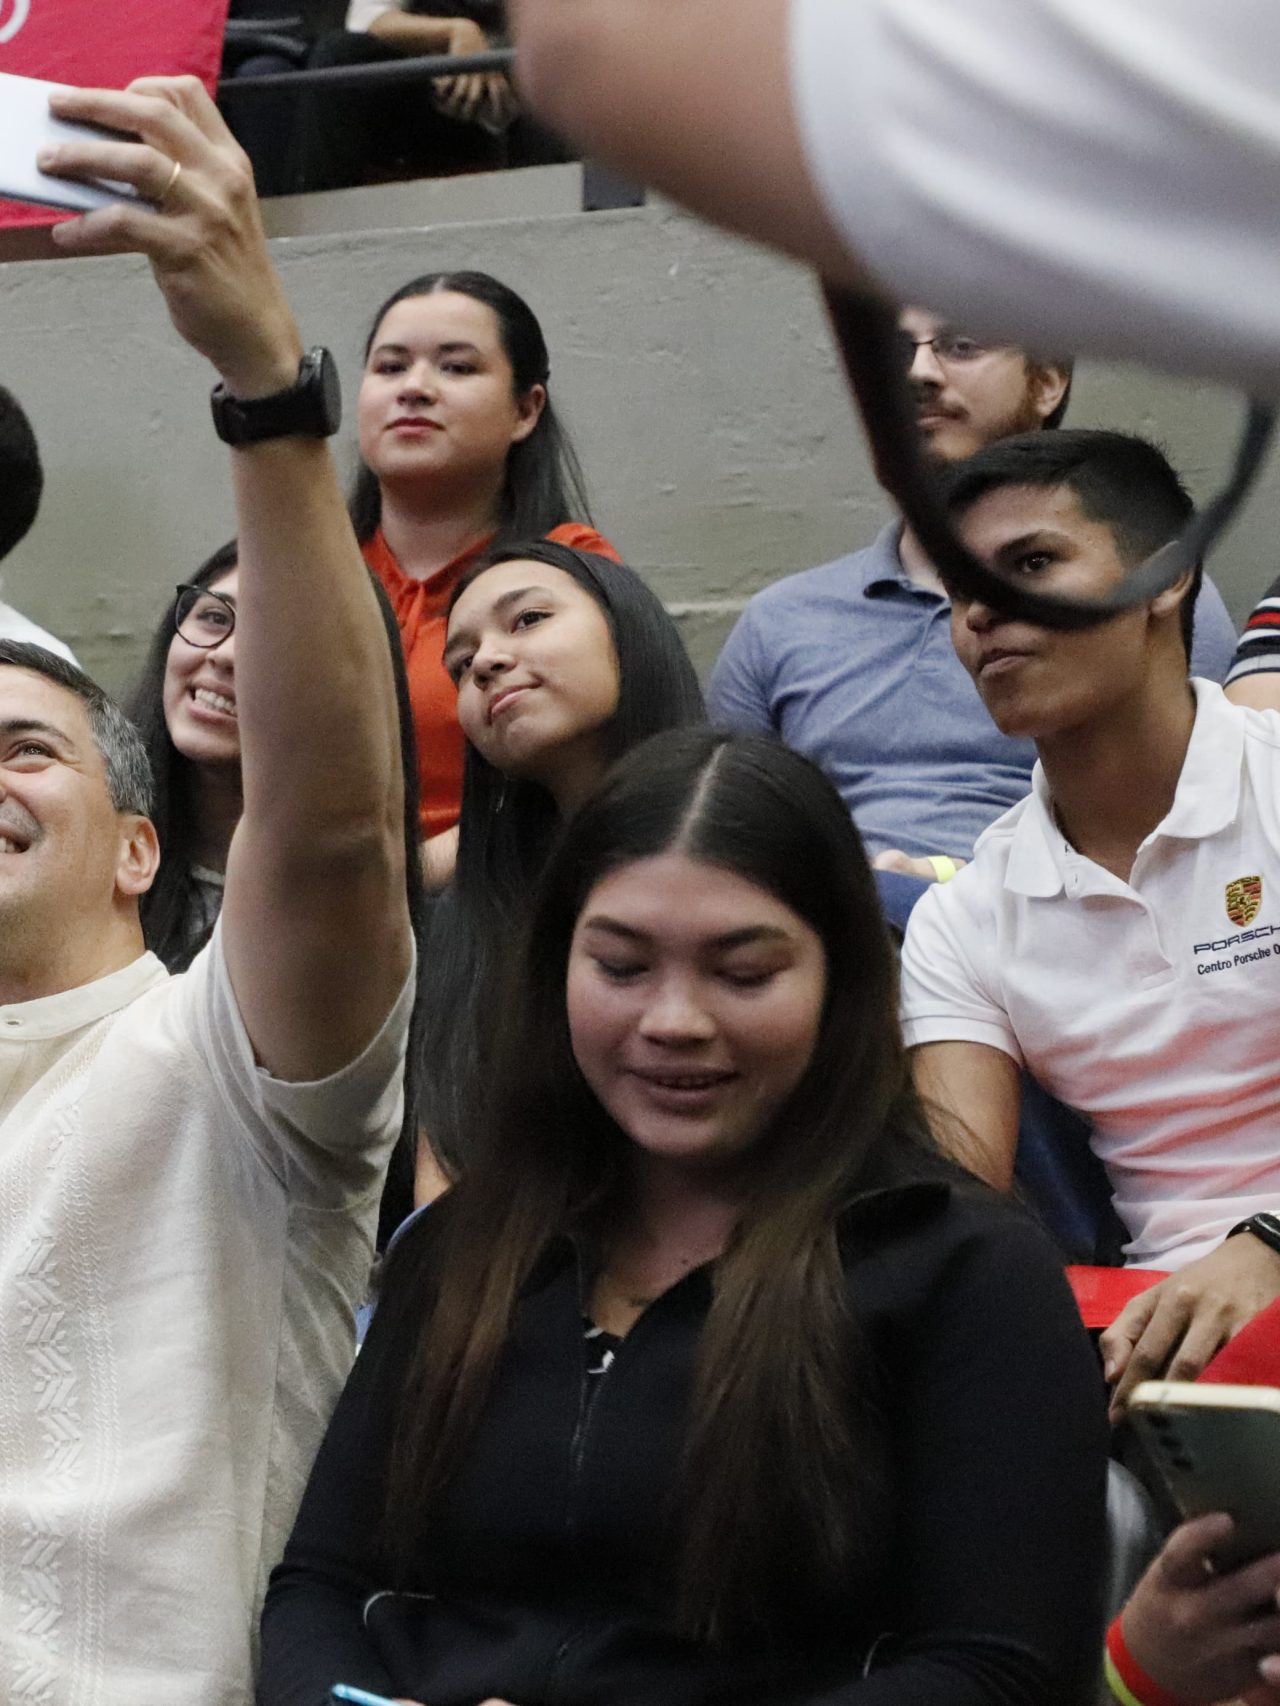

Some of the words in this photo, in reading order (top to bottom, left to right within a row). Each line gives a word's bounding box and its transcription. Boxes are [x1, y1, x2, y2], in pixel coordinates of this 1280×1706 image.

[1193, 925, 1280, 955] PORSCH
[1197, 960, 1232, 975] Centro
[1234, 948, 1271, 967] Porsche
